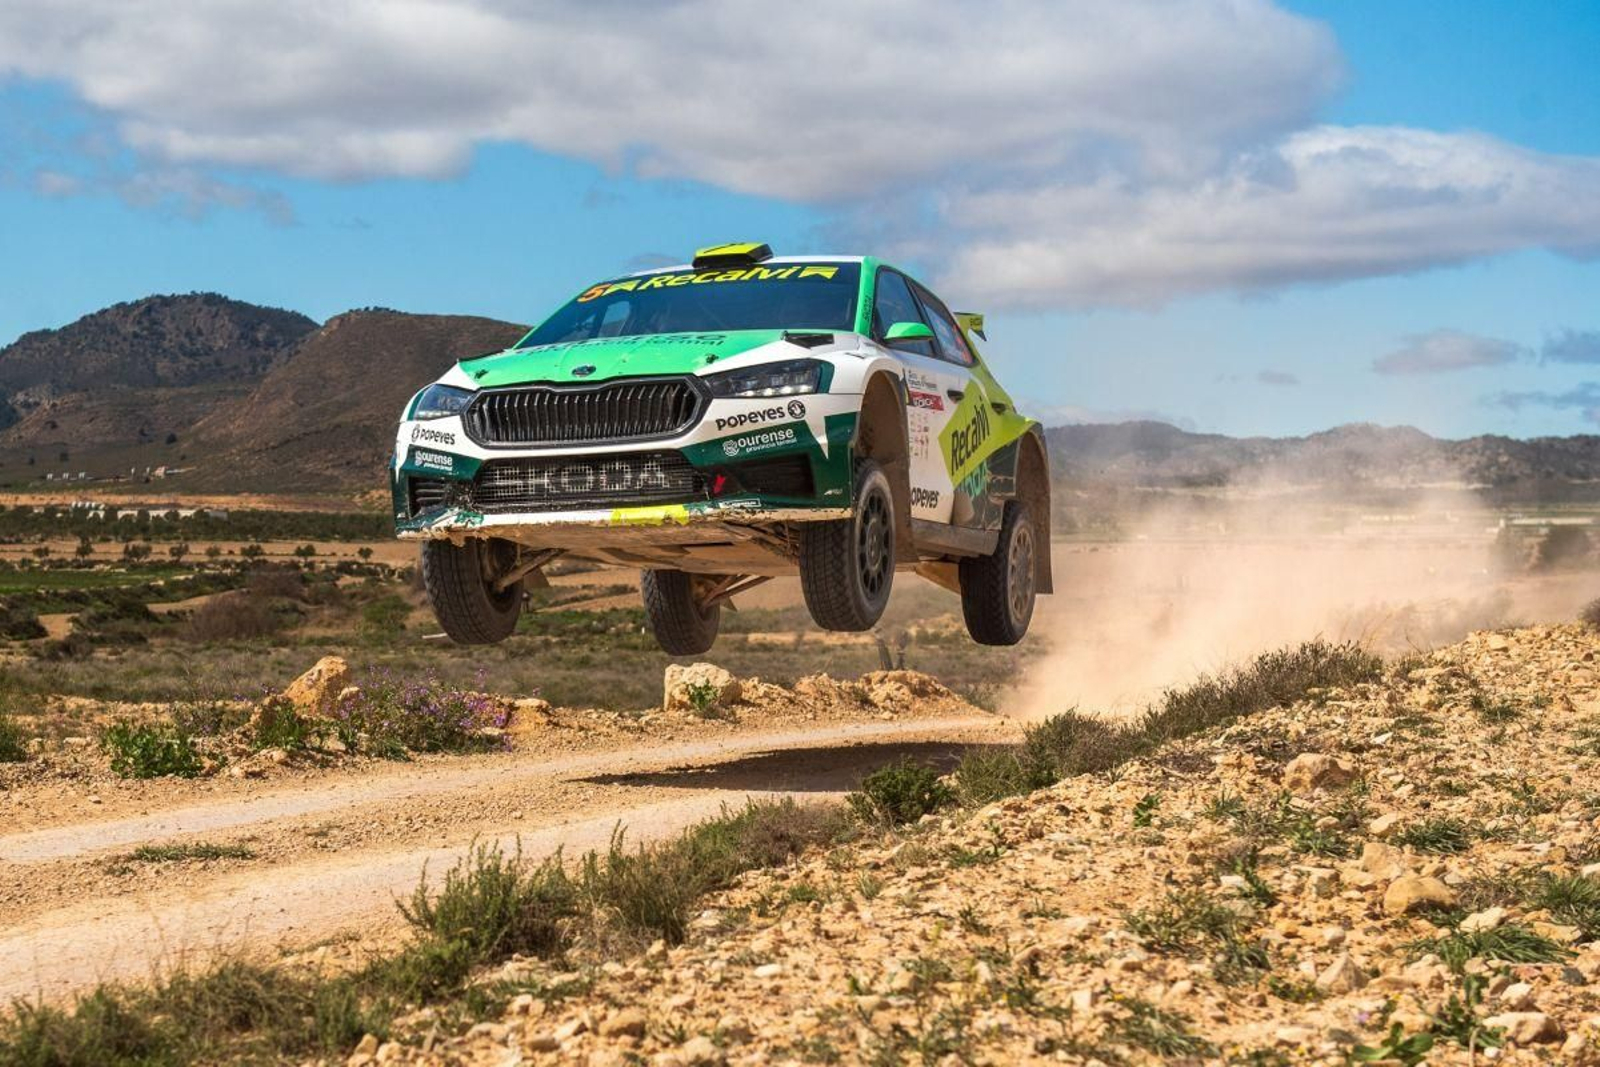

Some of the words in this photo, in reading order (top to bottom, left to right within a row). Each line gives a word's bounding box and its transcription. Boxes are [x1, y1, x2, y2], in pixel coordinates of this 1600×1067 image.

[577, 283, 612, 302] 5
[638, 266, 801, 290] Recalvi
[738, 428, 795, 448] ourense
[911, 487, 940, 509] OPEYES
